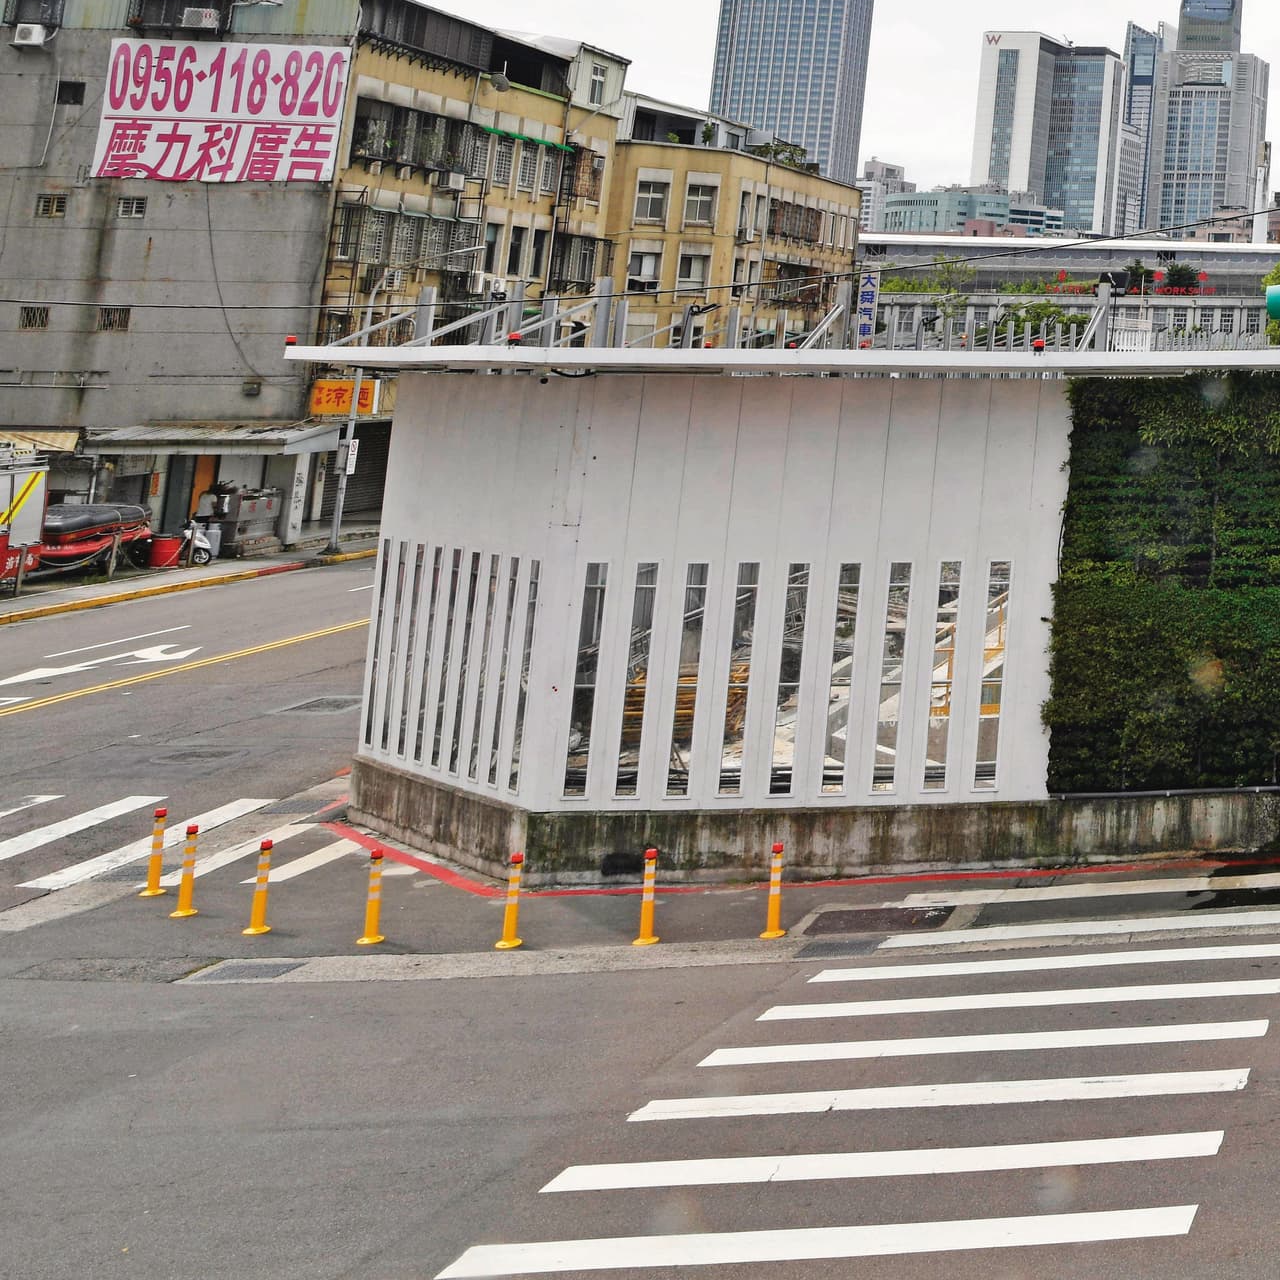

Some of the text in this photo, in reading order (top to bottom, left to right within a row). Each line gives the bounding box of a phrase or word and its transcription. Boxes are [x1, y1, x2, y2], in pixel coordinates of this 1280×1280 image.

[986, 34, 1002, 46] W
[859, 274, 876, 337] 大舜汽車
